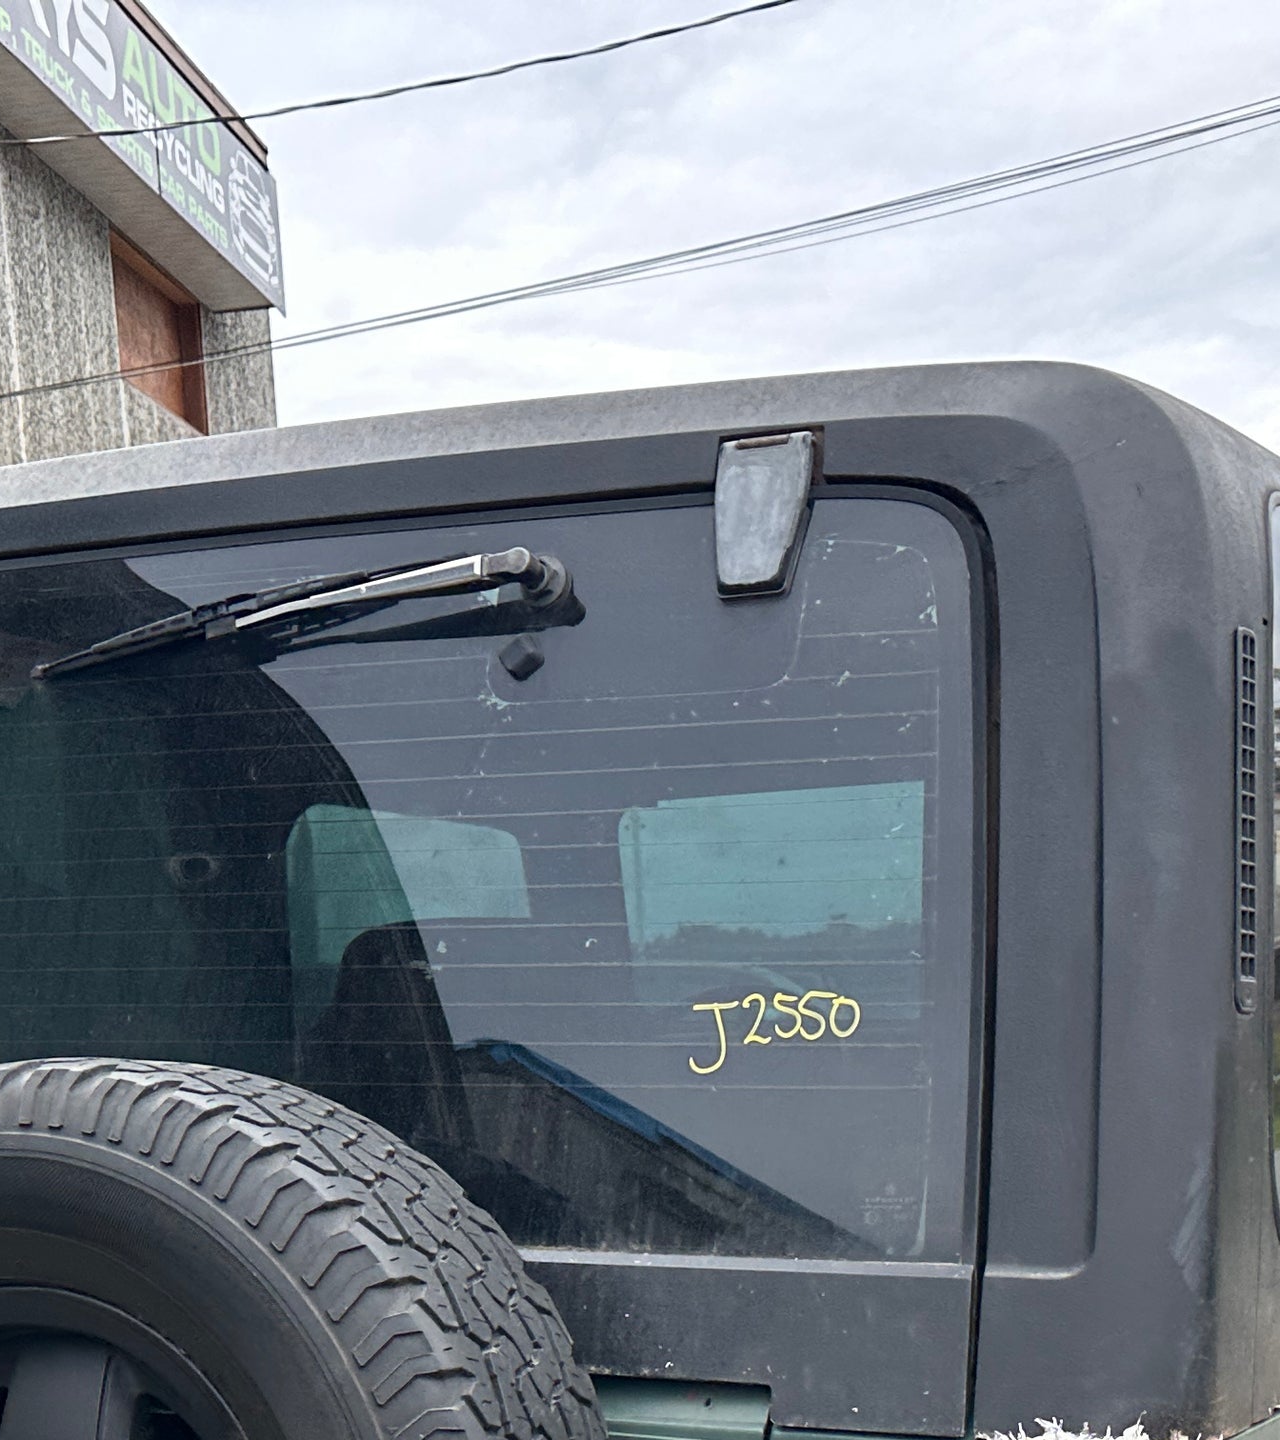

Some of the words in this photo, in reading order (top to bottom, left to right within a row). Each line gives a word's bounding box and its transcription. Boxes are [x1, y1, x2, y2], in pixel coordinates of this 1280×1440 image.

[28, 0, 117, 101] YS
[121, 27, 221, 177] AUTO
[20, 27, 77, 103] TRUCK
[81, 88, 93, 118] &
[187, 195, 229, 251] PARTS
[121, 82, 226, 215] RECYCLING
[688, 990, 861, 1075] J2550
